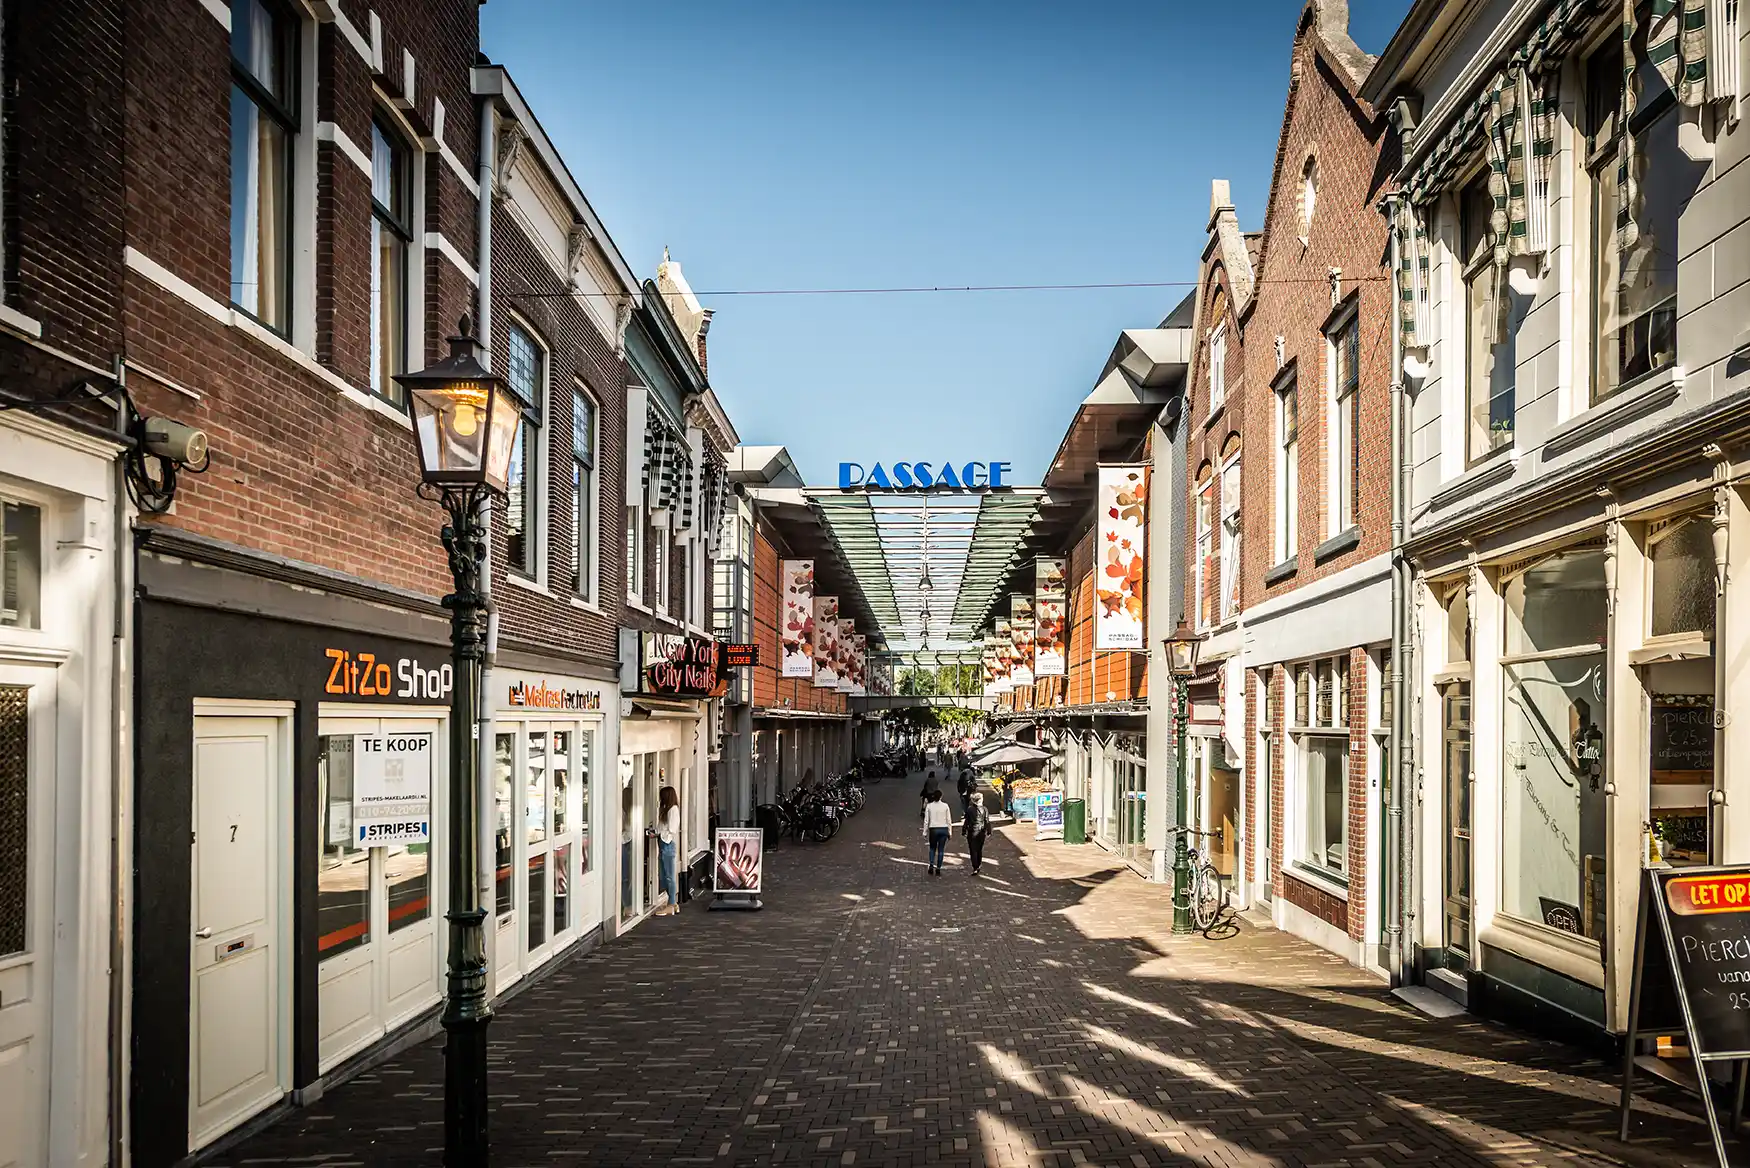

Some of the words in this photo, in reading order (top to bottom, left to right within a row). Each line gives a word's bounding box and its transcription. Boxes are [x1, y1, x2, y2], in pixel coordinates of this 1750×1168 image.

[838, 461, 1012, 489] PASSAGE
[654, 633, 687, 662] New
[690, 638, 718, 664] York
[324, 648, 392, 696] ZitZo
[397, 658, 453, 699] Shop
[655, 661, 683, 693] City
[685, 664, 717, 691] Nails
[362, 739, 382, 752] TE
[386, 738, 428, 752] KOOP
[361, 794, 428, 803] STRIPES-MAKELAARDIJ.NL
[230, 824, 239, 843] 7
[368, 822, 421, 836] STRIPES
[1690, 884, 1720, 905] LET
[1546, 911, 1578, 935] OPEN
